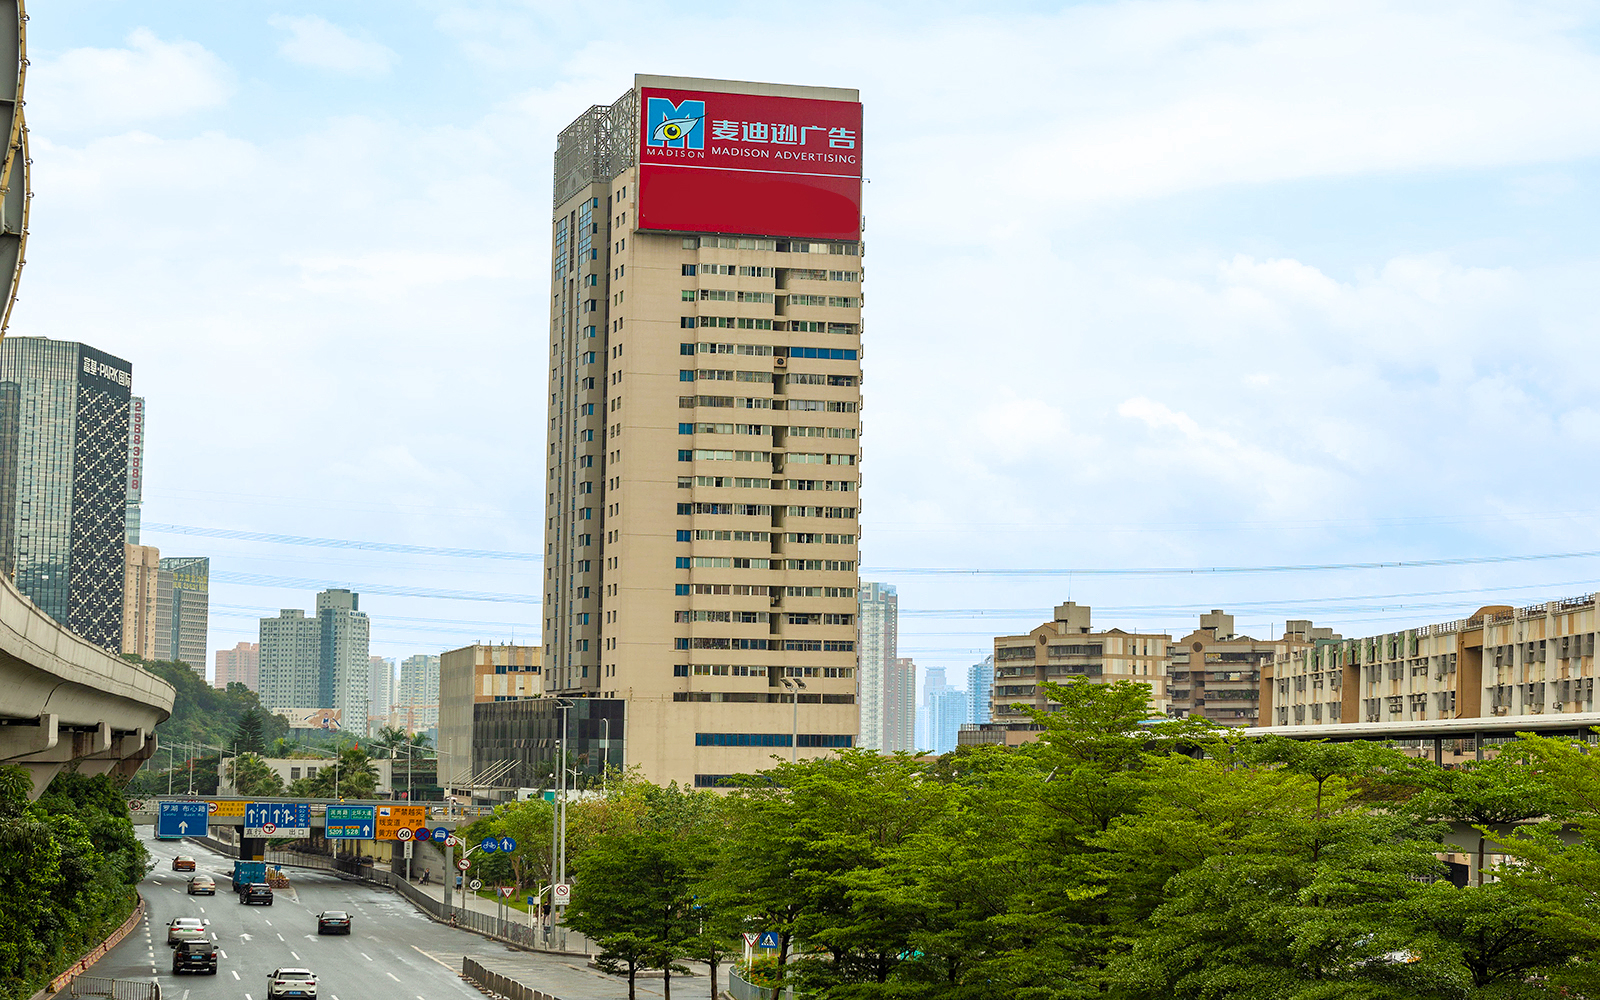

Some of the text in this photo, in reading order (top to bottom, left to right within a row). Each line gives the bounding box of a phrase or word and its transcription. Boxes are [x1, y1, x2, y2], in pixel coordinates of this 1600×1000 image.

[711, 119, 856, 150] 麦迪逊广告
[646, 148, 705, 159] MADISON
[711, 146, 857, 164] MADISON ADVERTISING
[131, 401, 142, 490] 25683888
[162, 804, 206, 813] 罗湖 布心路
[399, 830, 410, 838] 60
